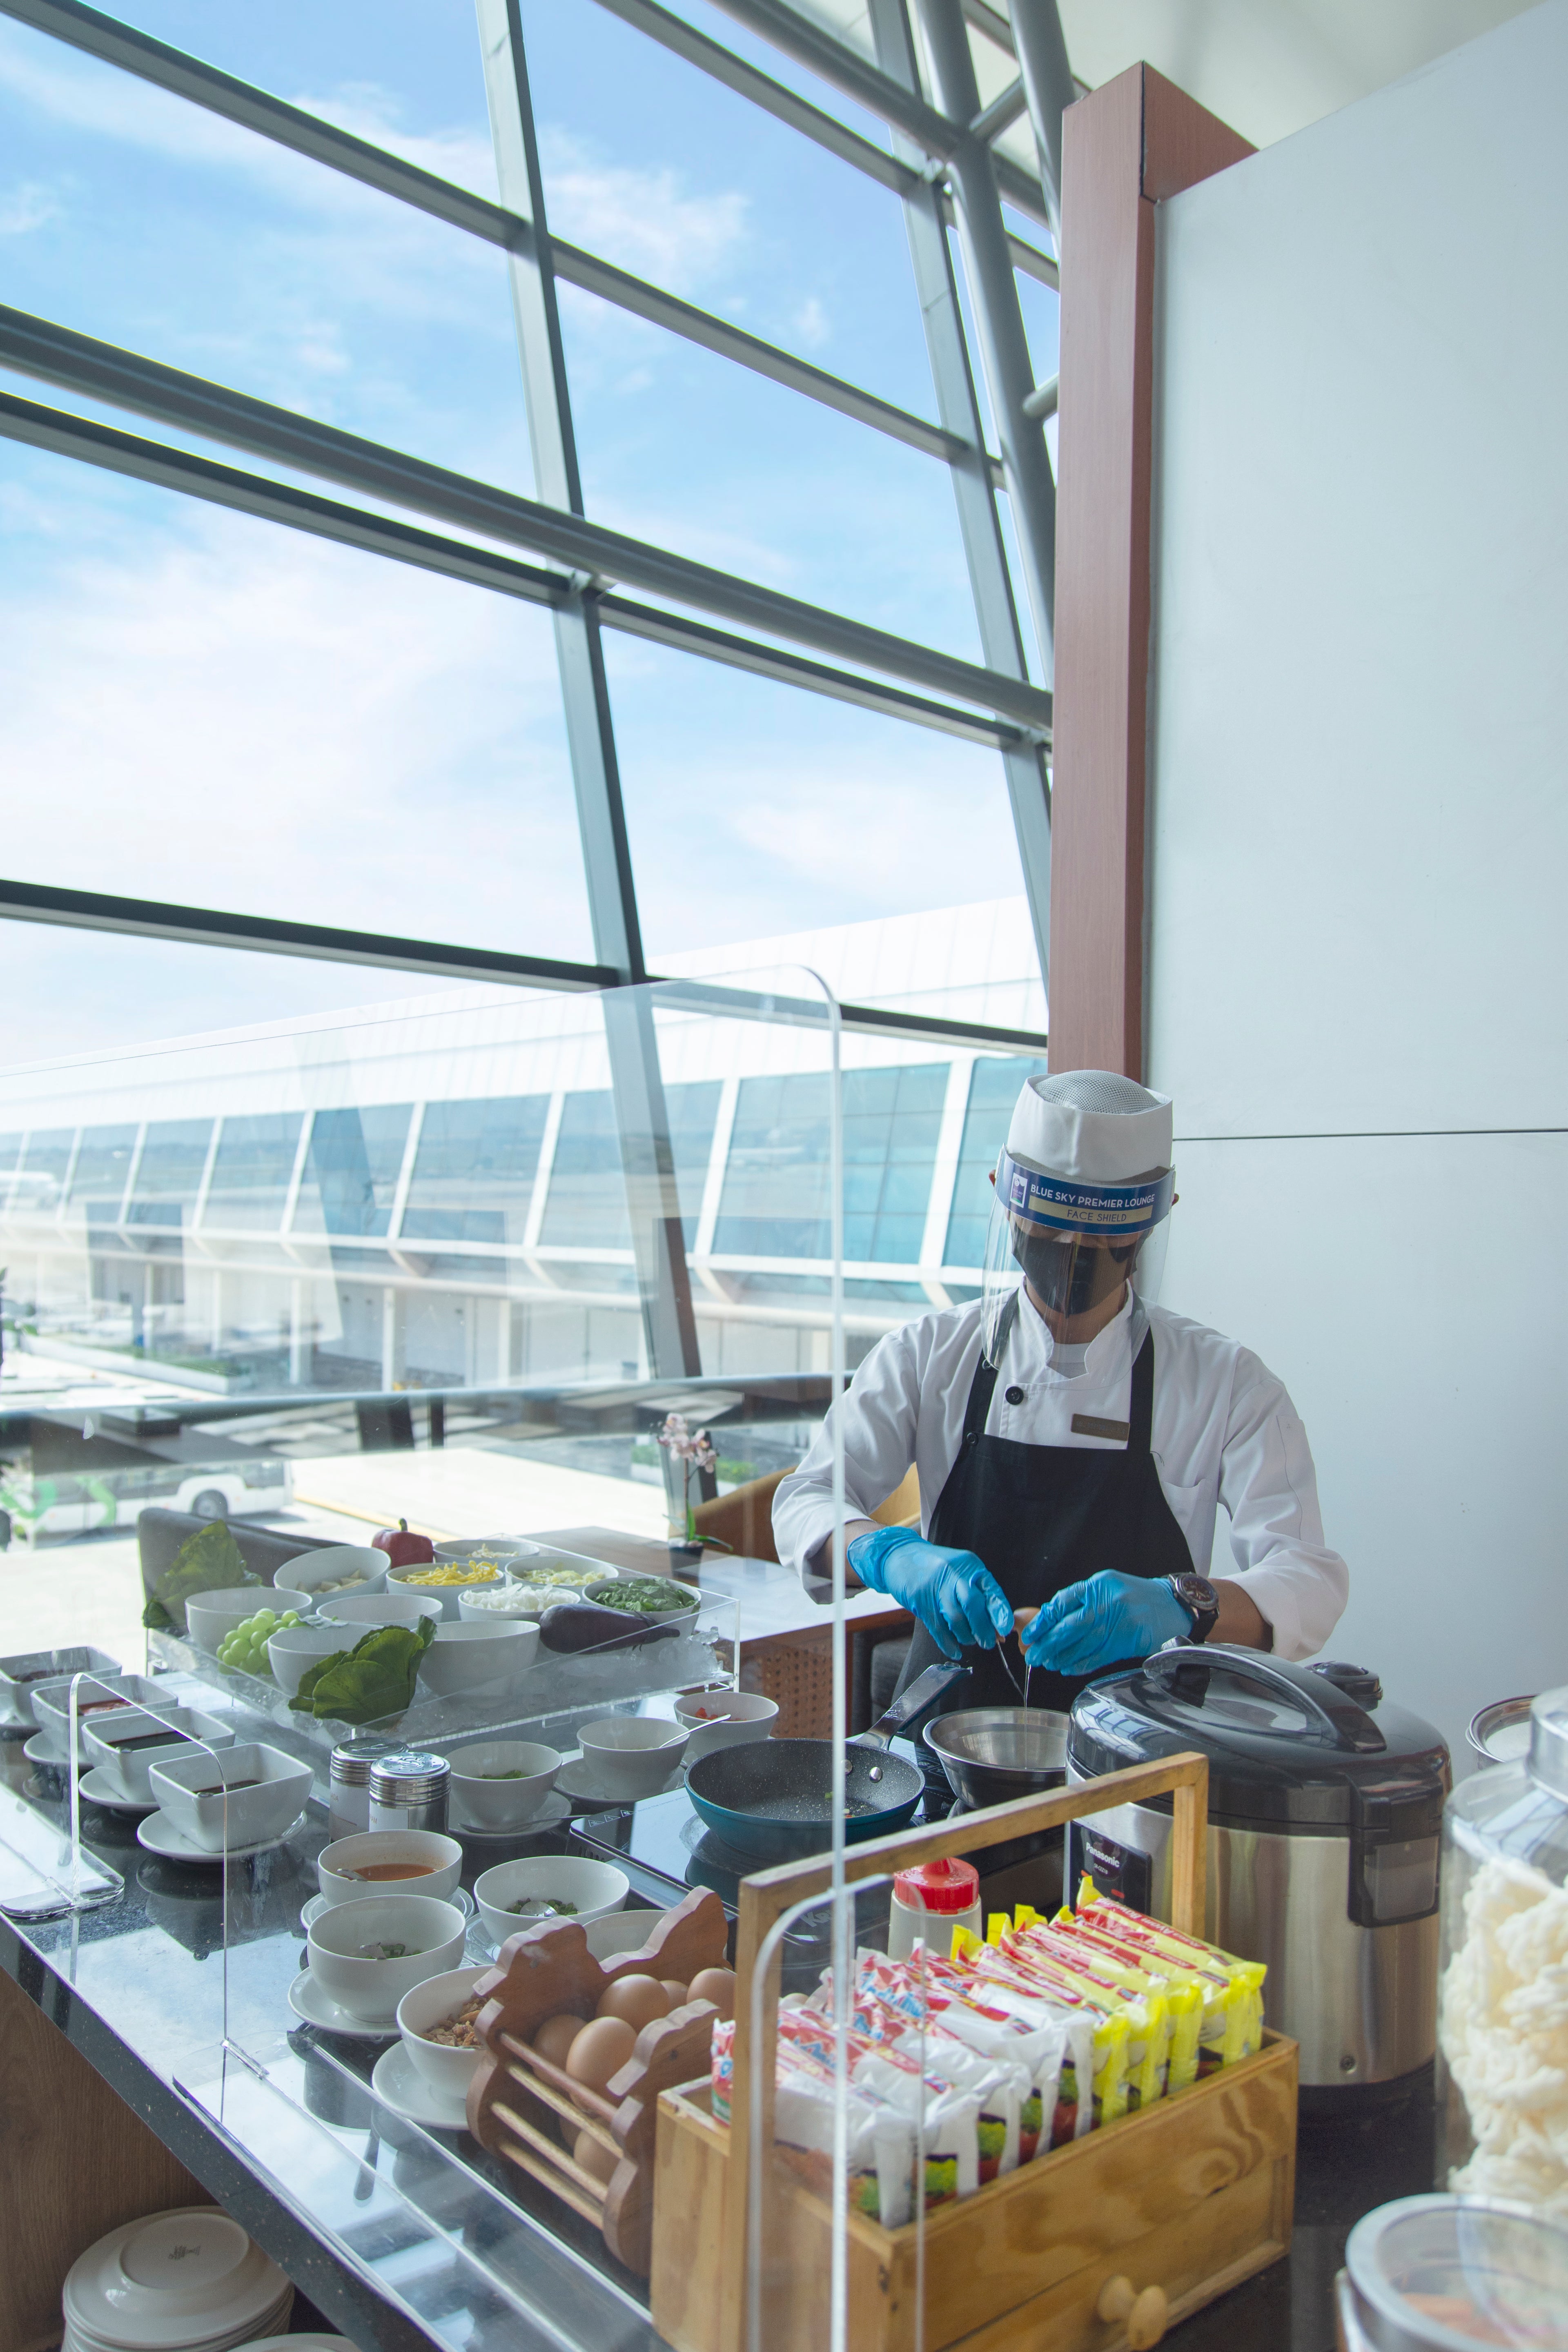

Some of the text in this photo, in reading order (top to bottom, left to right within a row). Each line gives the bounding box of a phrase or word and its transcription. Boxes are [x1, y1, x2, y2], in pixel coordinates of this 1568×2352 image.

[1031, 1184, 1155, 1207] BLUE SKY PREMIER LOUNGE
[1067, 1209, 1127, 1222] FACE SHIELD
[1086, 1842, 1120, 1868] Panasonic
